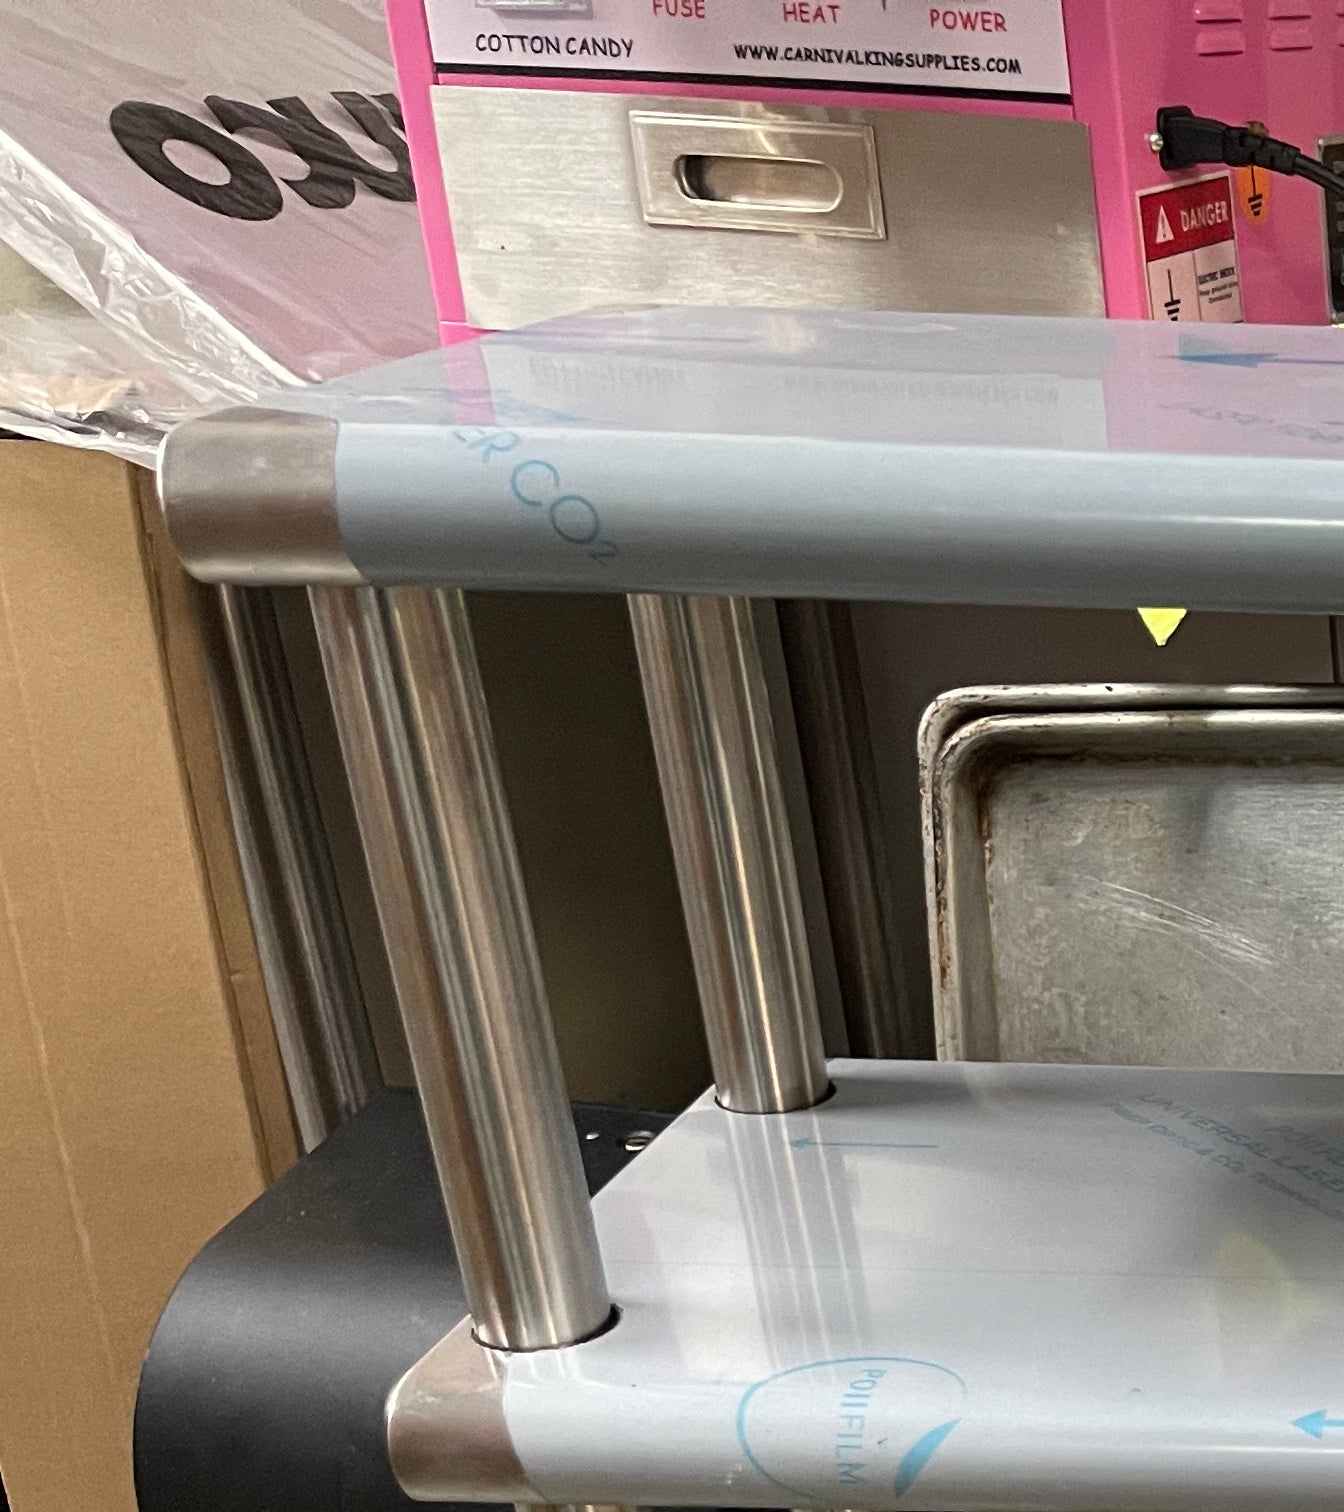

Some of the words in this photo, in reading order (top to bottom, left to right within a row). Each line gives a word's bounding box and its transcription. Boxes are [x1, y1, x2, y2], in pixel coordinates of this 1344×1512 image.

[652, 0, 706, 20] FUSE
[782, 3, 840, 24] HEAT
[929, 8, 1008, 33] POWER
[475, 34, 561, 55] COTTON
[566, 36, 634, 59] CANDY
[733, 44, 1022, 76] WWW.CARNIVALKINGSUPPLIES.COM
[1179, 199, 1229, 232] DANGER
